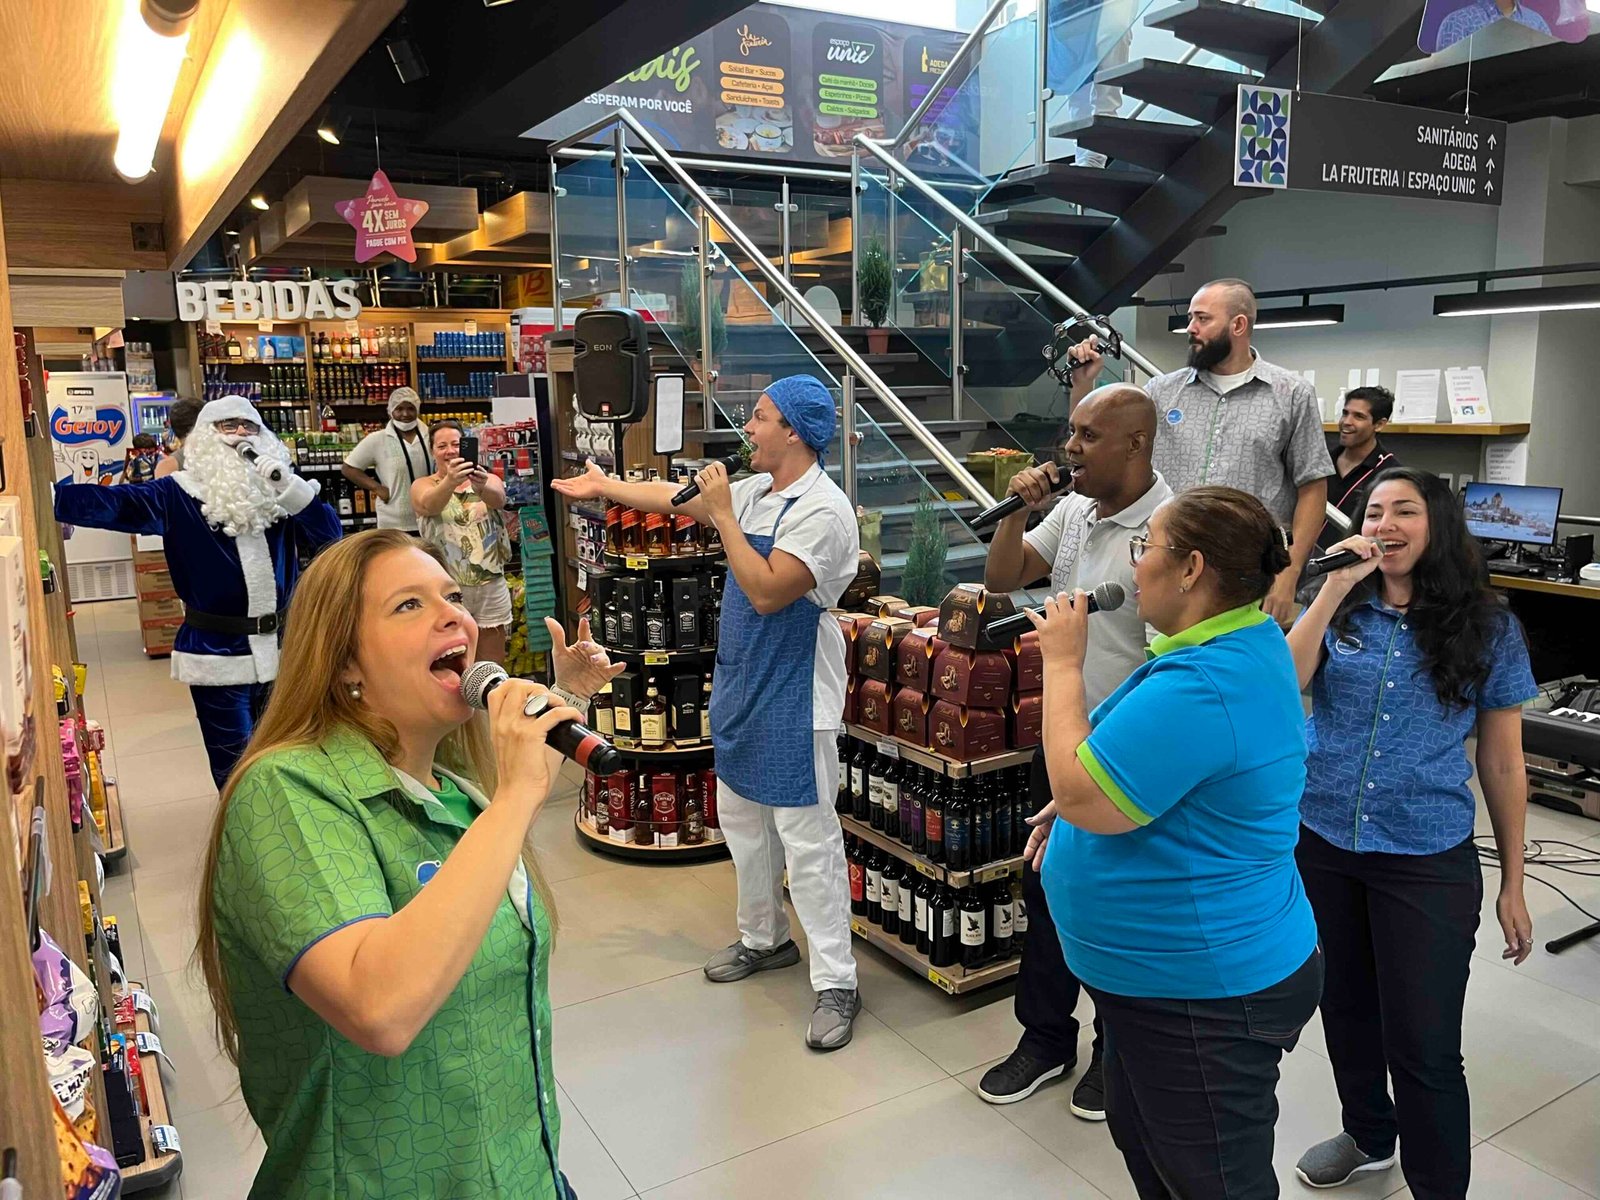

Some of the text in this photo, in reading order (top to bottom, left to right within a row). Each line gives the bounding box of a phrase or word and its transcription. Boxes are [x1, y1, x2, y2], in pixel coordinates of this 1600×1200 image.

[728, 64, 744, 73] Salad
[759, 69, 776, 77] Sucos
[731, 79, 756, 88] Cafeteria
[639, 98, 662, 110] POR
[663, 100, 693, 114] VOCÊ
[1417, 125, 1479, 150] SANITÁRIOS
[1442, 152, 1477, 172] ADEGA
[1322, 163, 1476, 196] LA FRUTERIA ESPAÇO UNIC
[362, 209, 385, 233] 4X
[384, 209, 399, 219] SEM
[386, 219, 407, 230] JUROS
[366, 236, 407, 248] PAGUE COM PIX
[177, 279, 362, 322] BEBIDAS
[72, 405, 83, 414] 17
